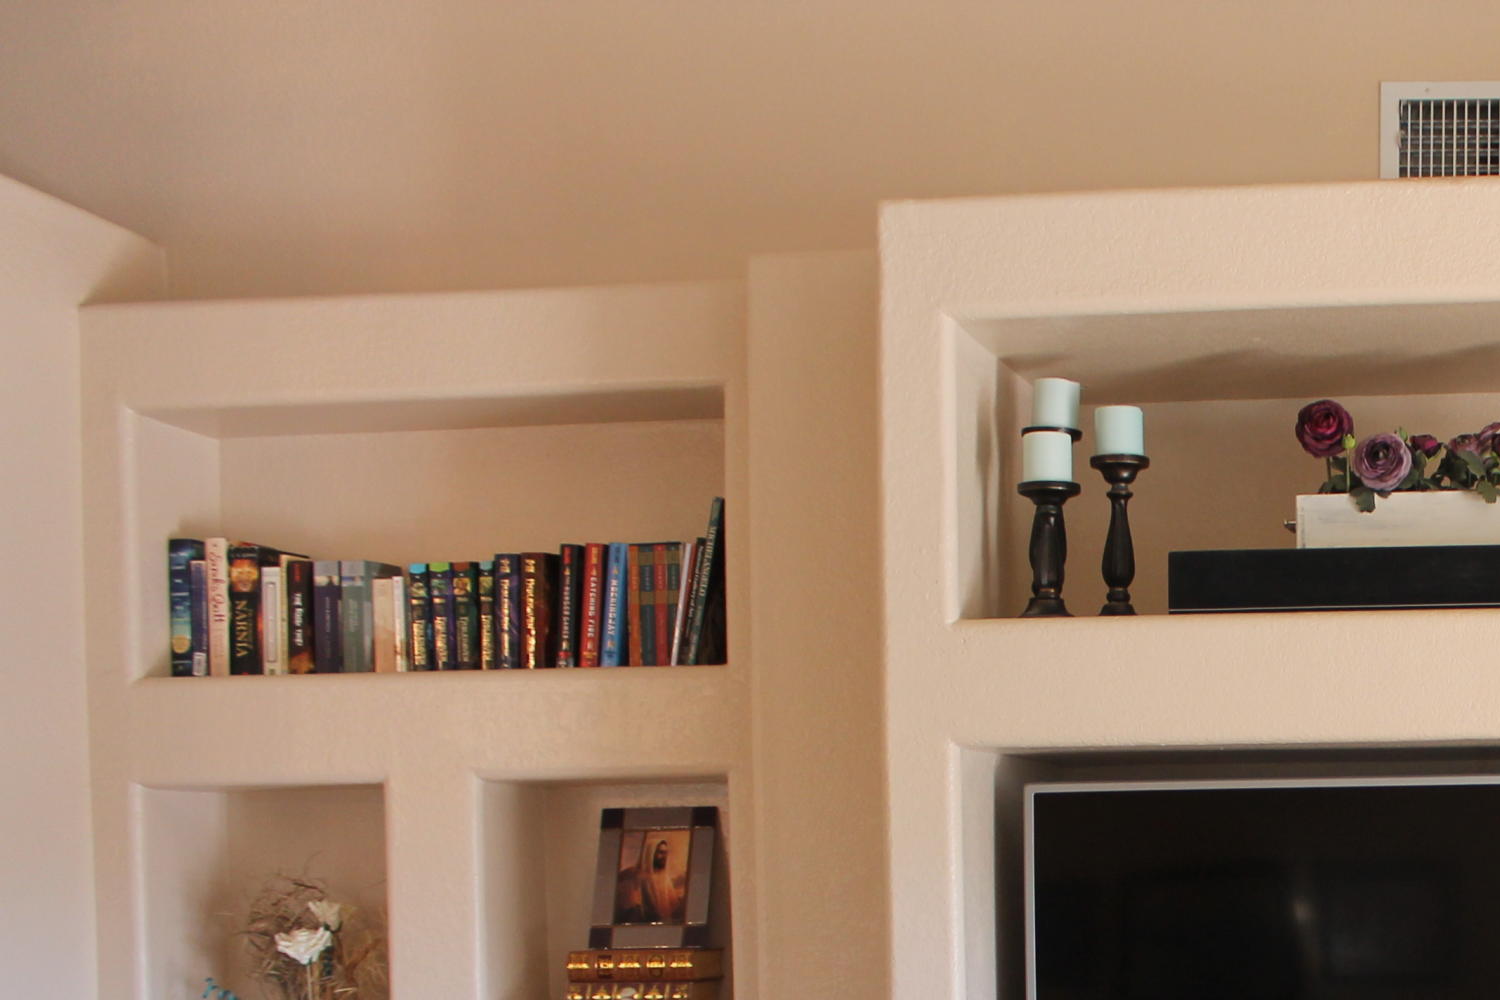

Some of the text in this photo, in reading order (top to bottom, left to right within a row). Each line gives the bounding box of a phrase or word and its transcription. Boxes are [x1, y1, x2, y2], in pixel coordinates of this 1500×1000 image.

[698, 526, 716, 597] MICHELANGELO
[294, 593, 303, 606] THE
[588, 577, 598, 616] CATCHING
[608, 579, 618, 635] MOCKINGJAY
[235, 600, 249, 657] NARNIA
